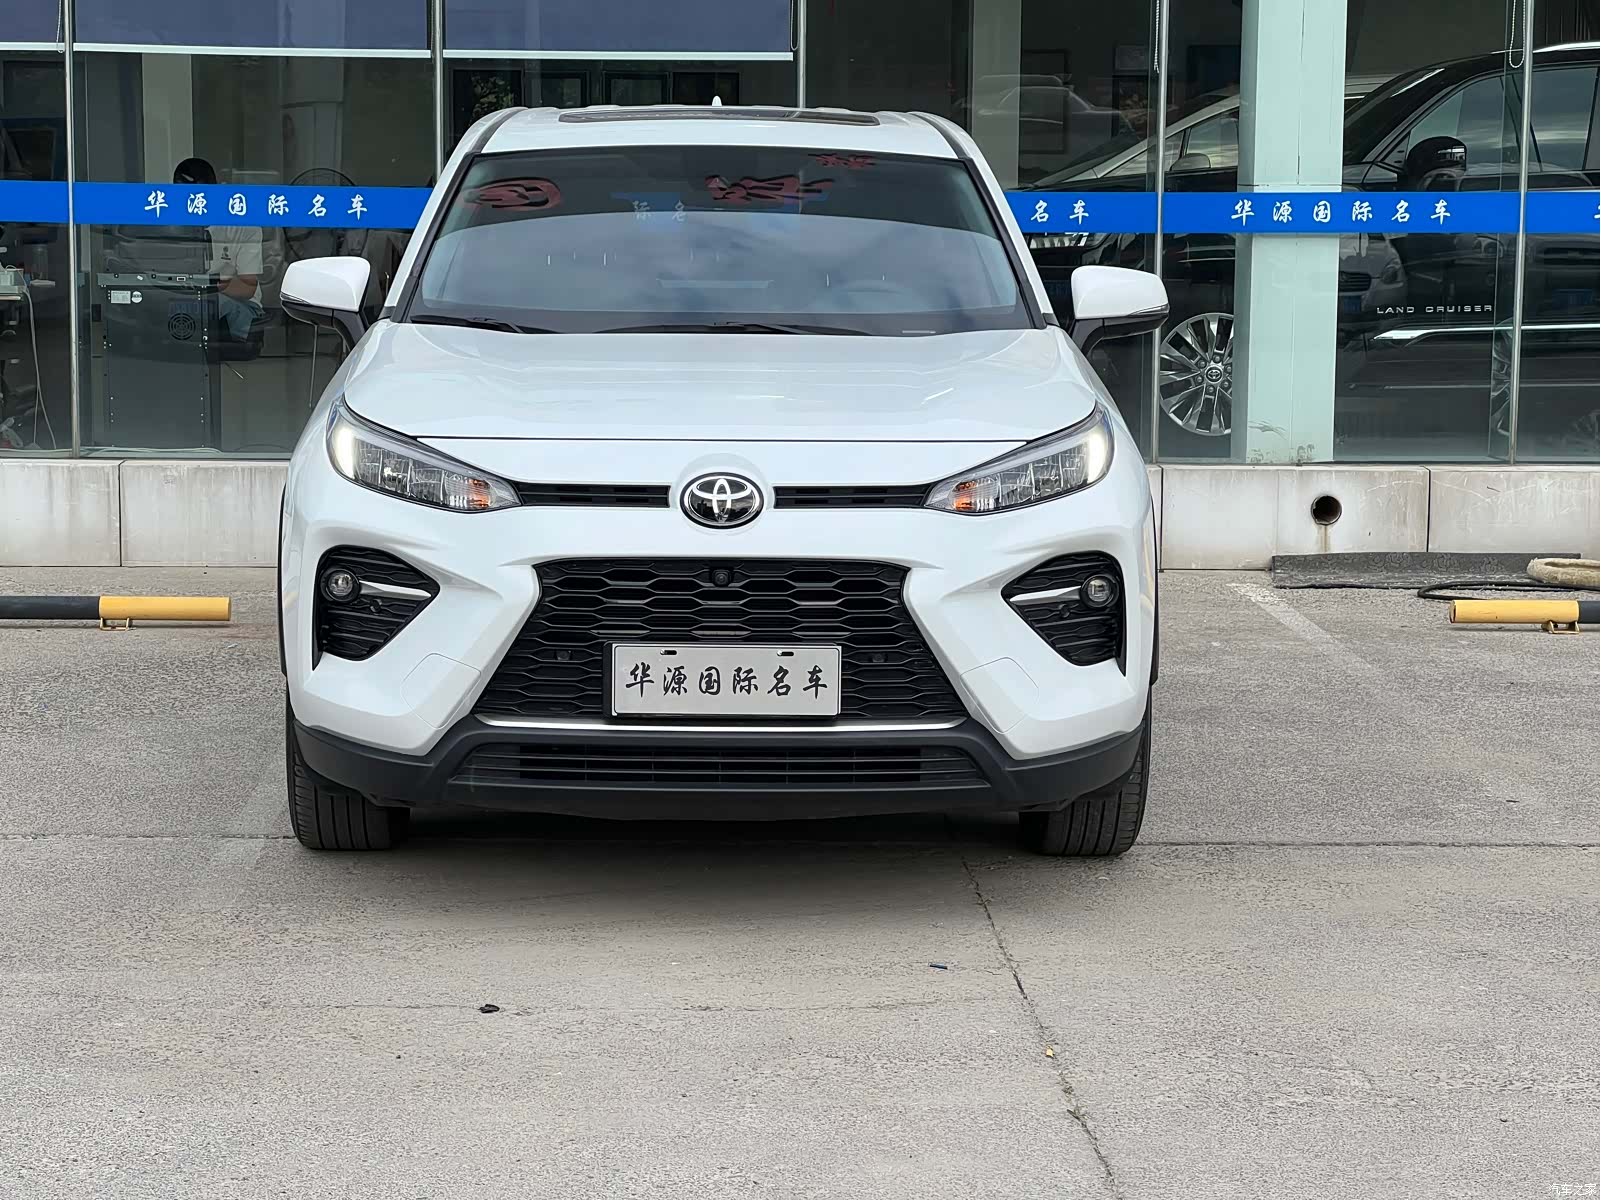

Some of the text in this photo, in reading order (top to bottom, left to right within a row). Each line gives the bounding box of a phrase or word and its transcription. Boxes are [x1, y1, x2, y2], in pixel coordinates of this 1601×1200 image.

[144, 190, 368, 220] 华源国际名车
[1031, 199, 1089, 225] 名车
[1231, 199, 1451, 225] 华源国际名车
[1376, 305, 1492, 314] LAND CRUISER
[625, 661, 828, 699] 华源国际名车
